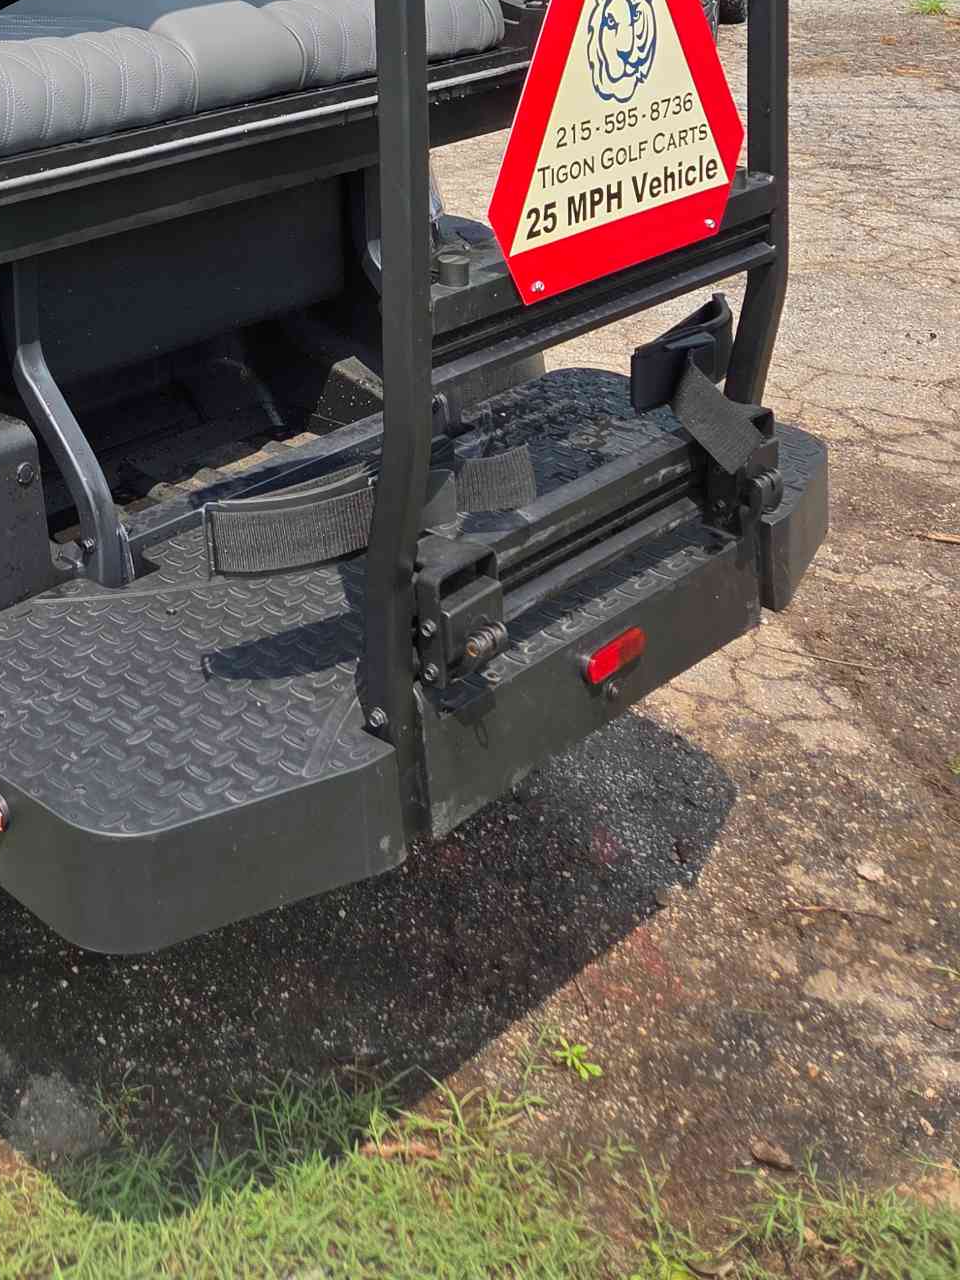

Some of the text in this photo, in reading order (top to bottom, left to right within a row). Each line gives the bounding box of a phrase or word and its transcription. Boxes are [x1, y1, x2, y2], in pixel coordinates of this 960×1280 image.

[537, 123, 708, 189] TIGON GOLF CARTS
[526, 155, 718, 240] 25 MPH Vehicle
